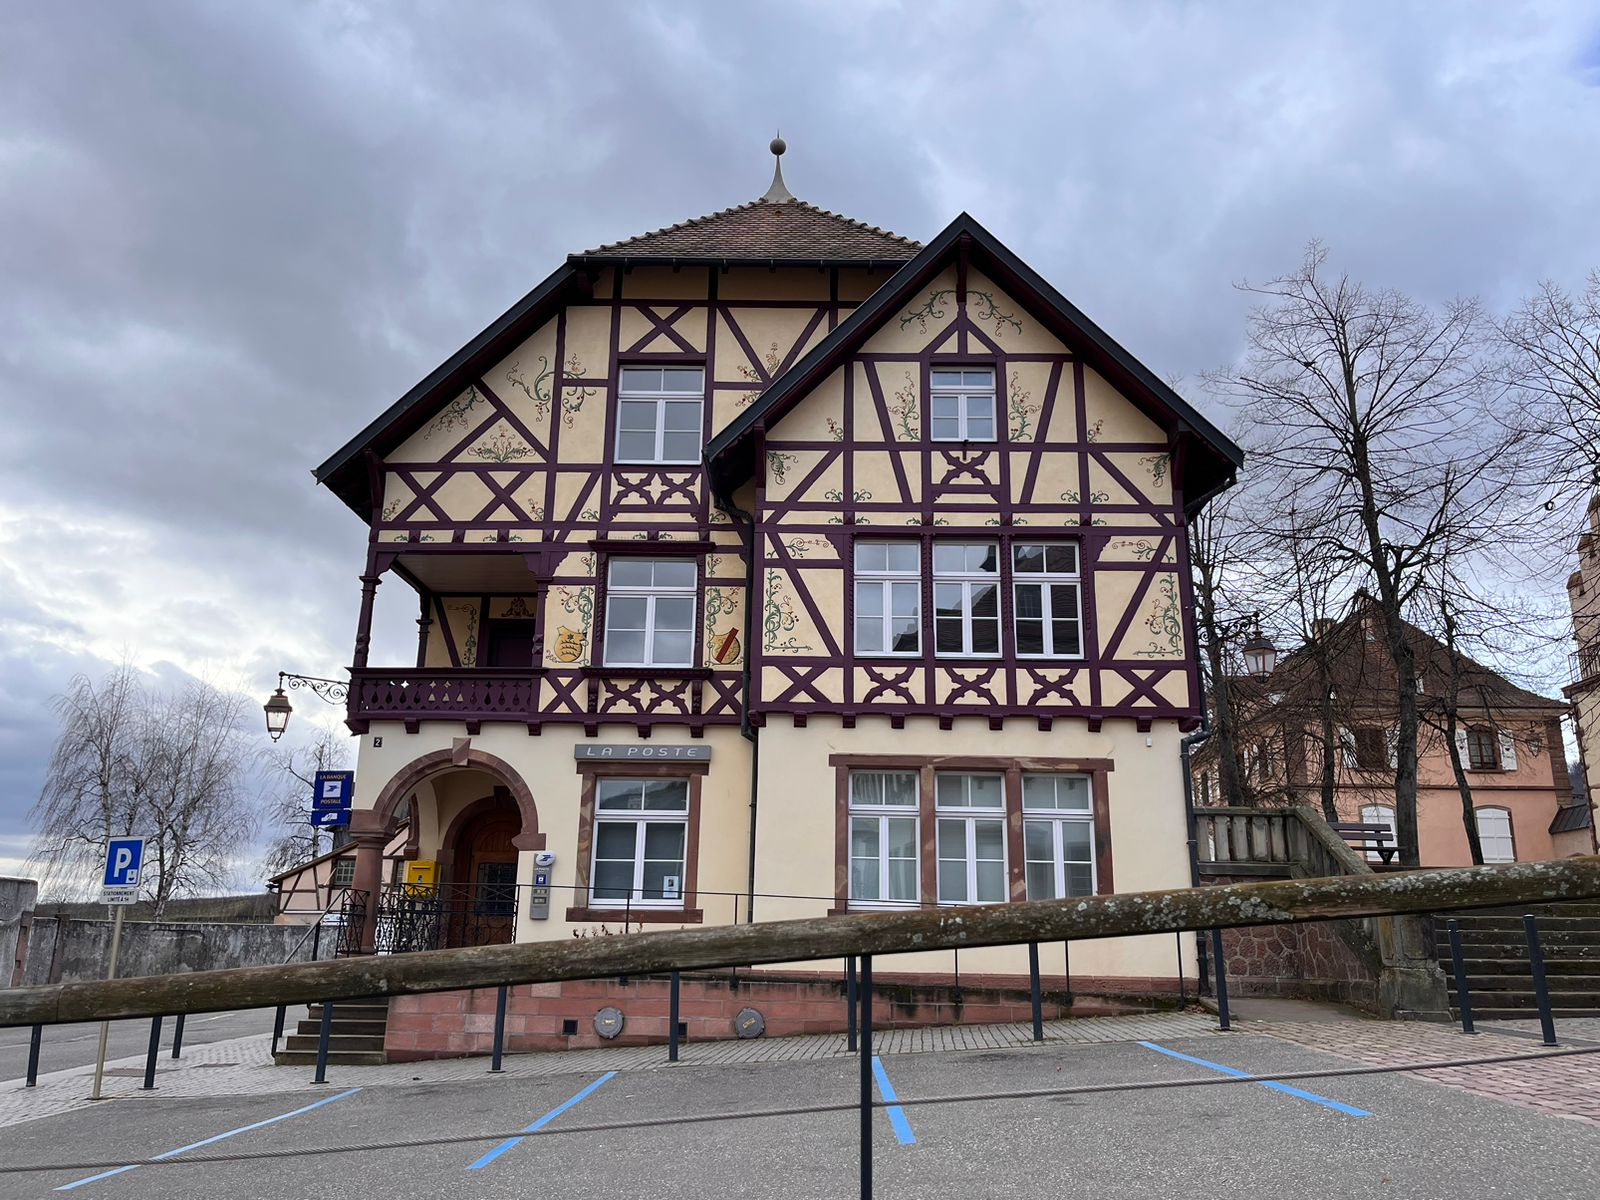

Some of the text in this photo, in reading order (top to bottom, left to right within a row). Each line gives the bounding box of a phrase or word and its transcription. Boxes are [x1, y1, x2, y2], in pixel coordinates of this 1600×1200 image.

[586, 747, 698, 757] LA POSTE
[113, 847, 132, 878] P
